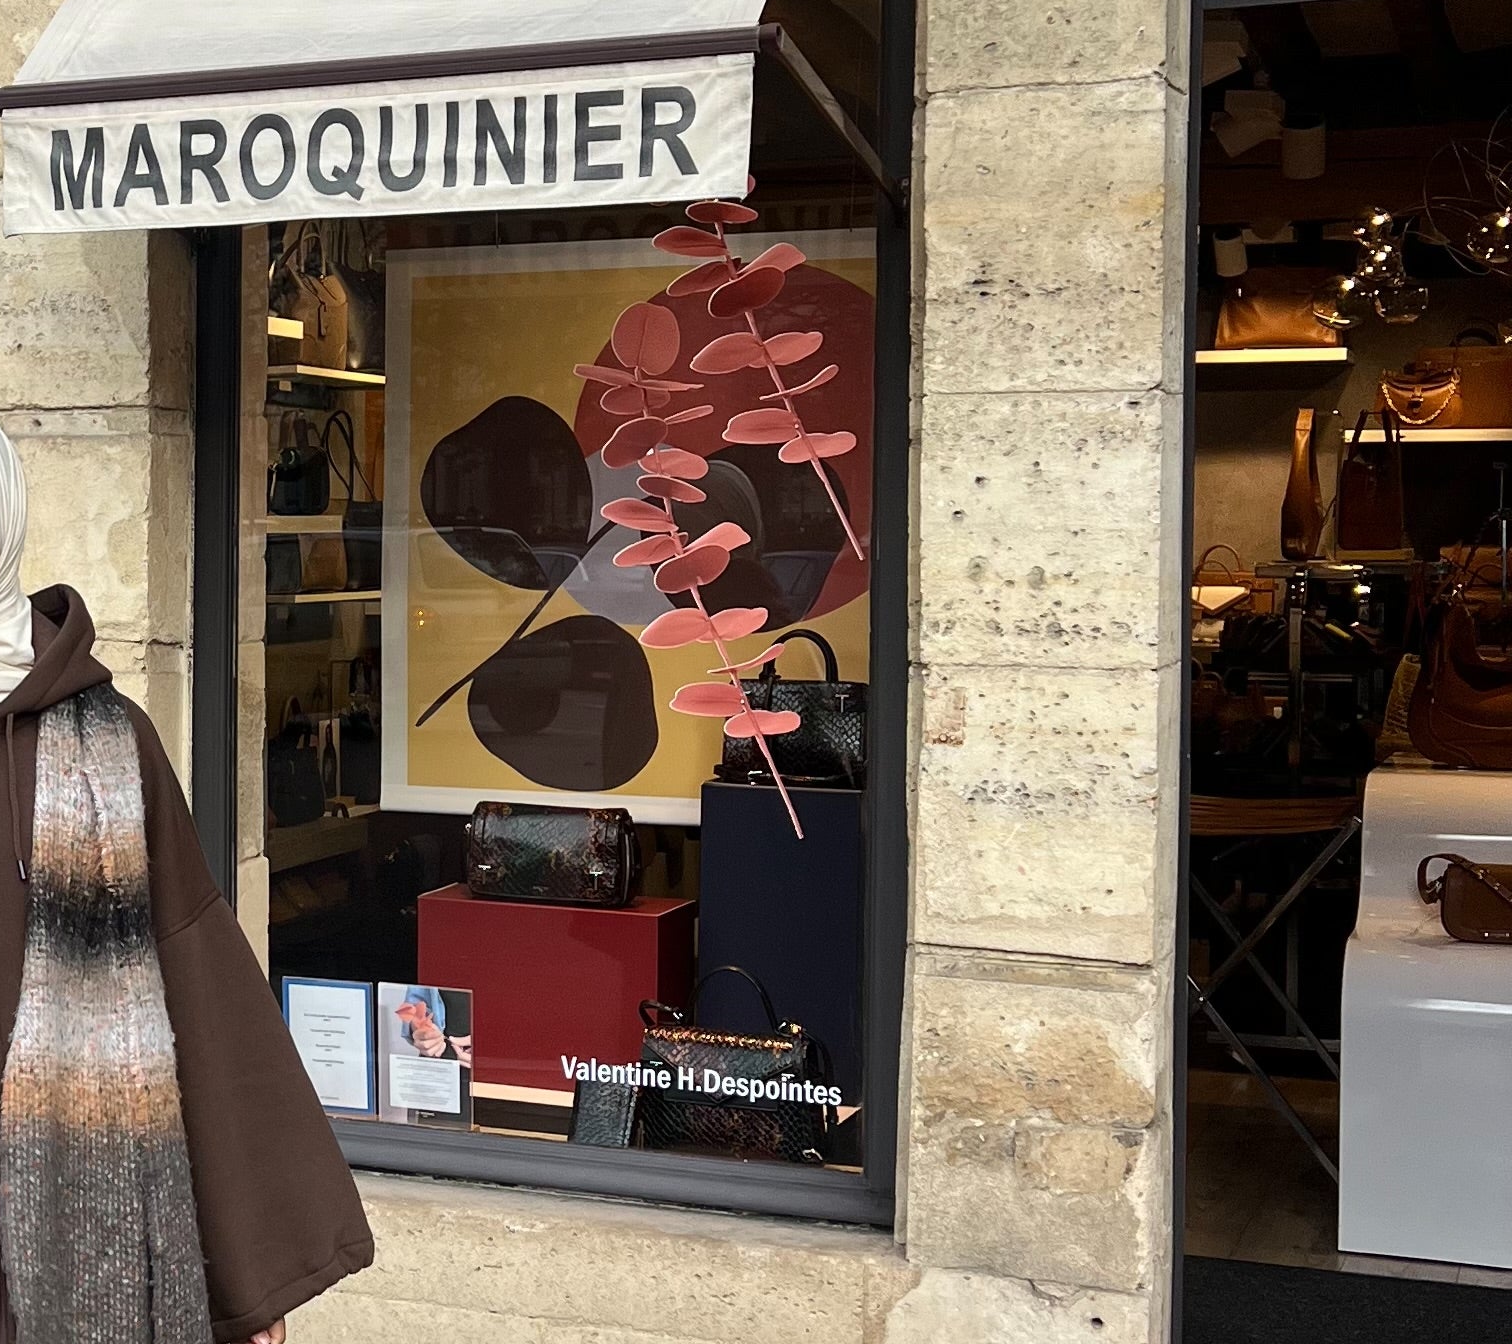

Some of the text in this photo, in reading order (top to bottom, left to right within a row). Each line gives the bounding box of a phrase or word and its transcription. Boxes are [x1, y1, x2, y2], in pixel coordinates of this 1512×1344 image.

[50, 85, 699, 211] MAROQUINIER
[560, 1055, 843, 1106] Valentine H.Despointes
